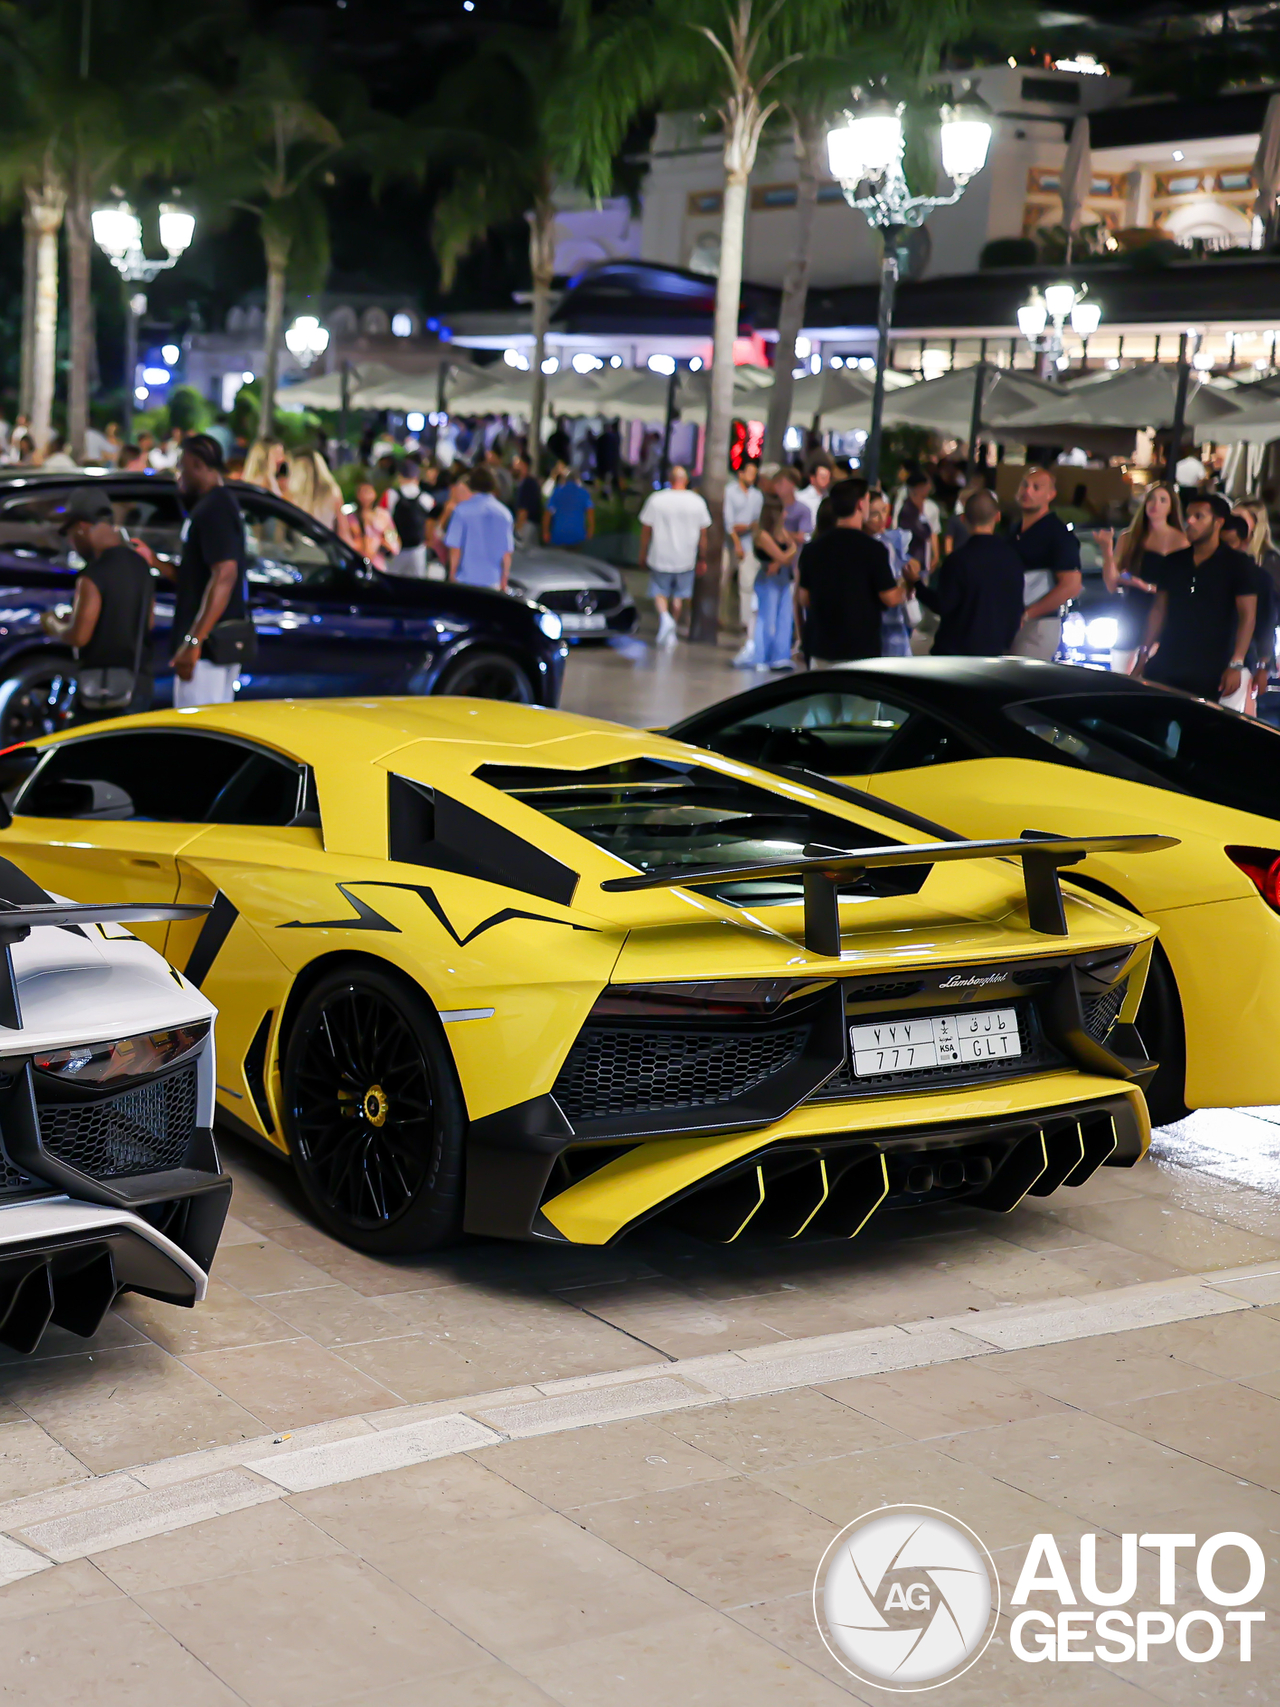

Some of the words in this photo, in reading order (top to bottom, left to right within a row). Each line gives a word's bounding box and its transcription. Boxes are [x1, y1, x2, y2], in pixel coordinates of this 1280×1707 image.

[939, 972, 1008, 989] Lamborghini
[940, 1044, 955, 1052] KSA
[876, 1048, 915, 1069] 777
